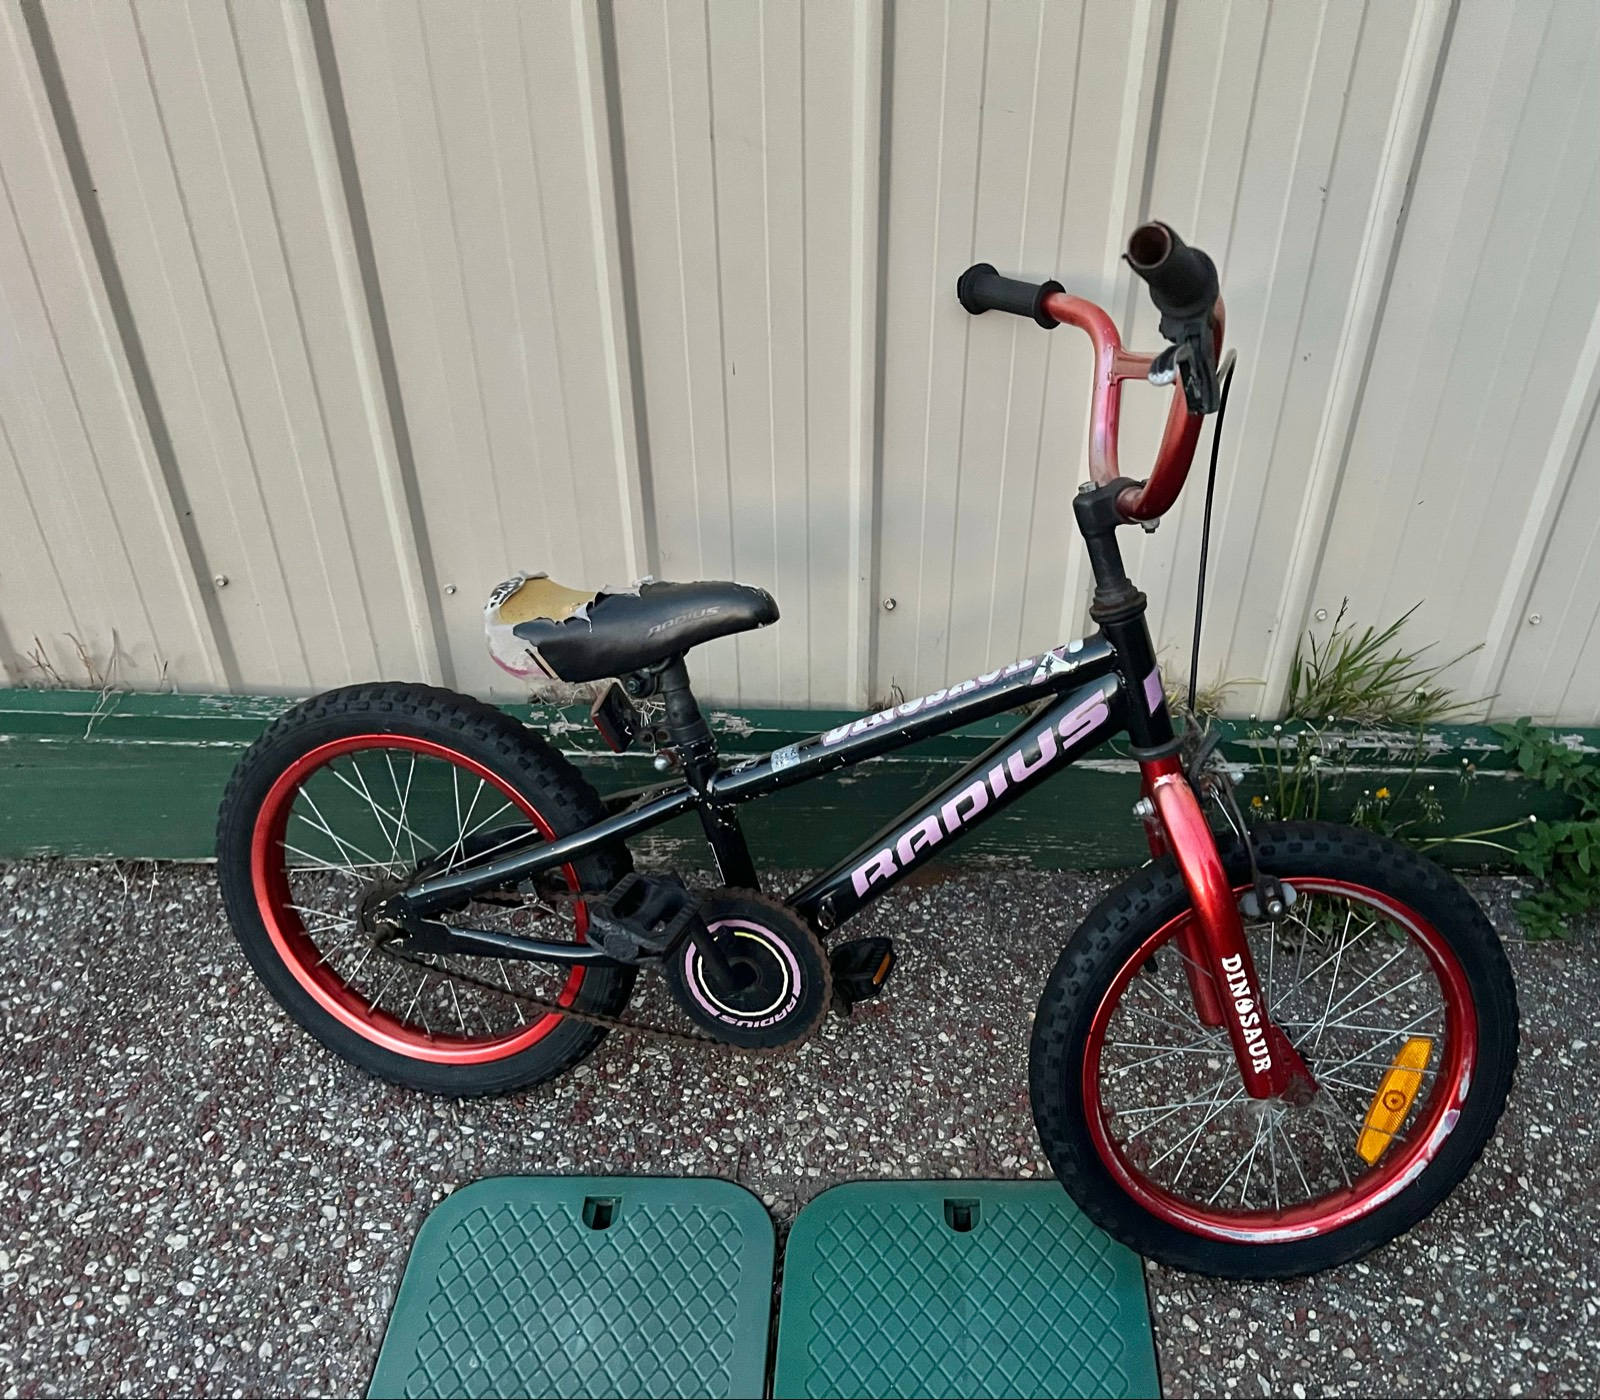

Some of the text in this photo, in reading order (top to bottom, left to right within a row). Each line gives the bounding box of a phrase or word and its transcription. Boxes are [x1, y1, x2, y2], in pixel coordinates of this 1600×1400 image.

[648, 606, 721, 639] RADIUS
[851, 689, 1111, 898] RADIUS
[718, 995, 798, 1028] RADIUS
[1222, 953, 1272, 1074] DINOSAUR
